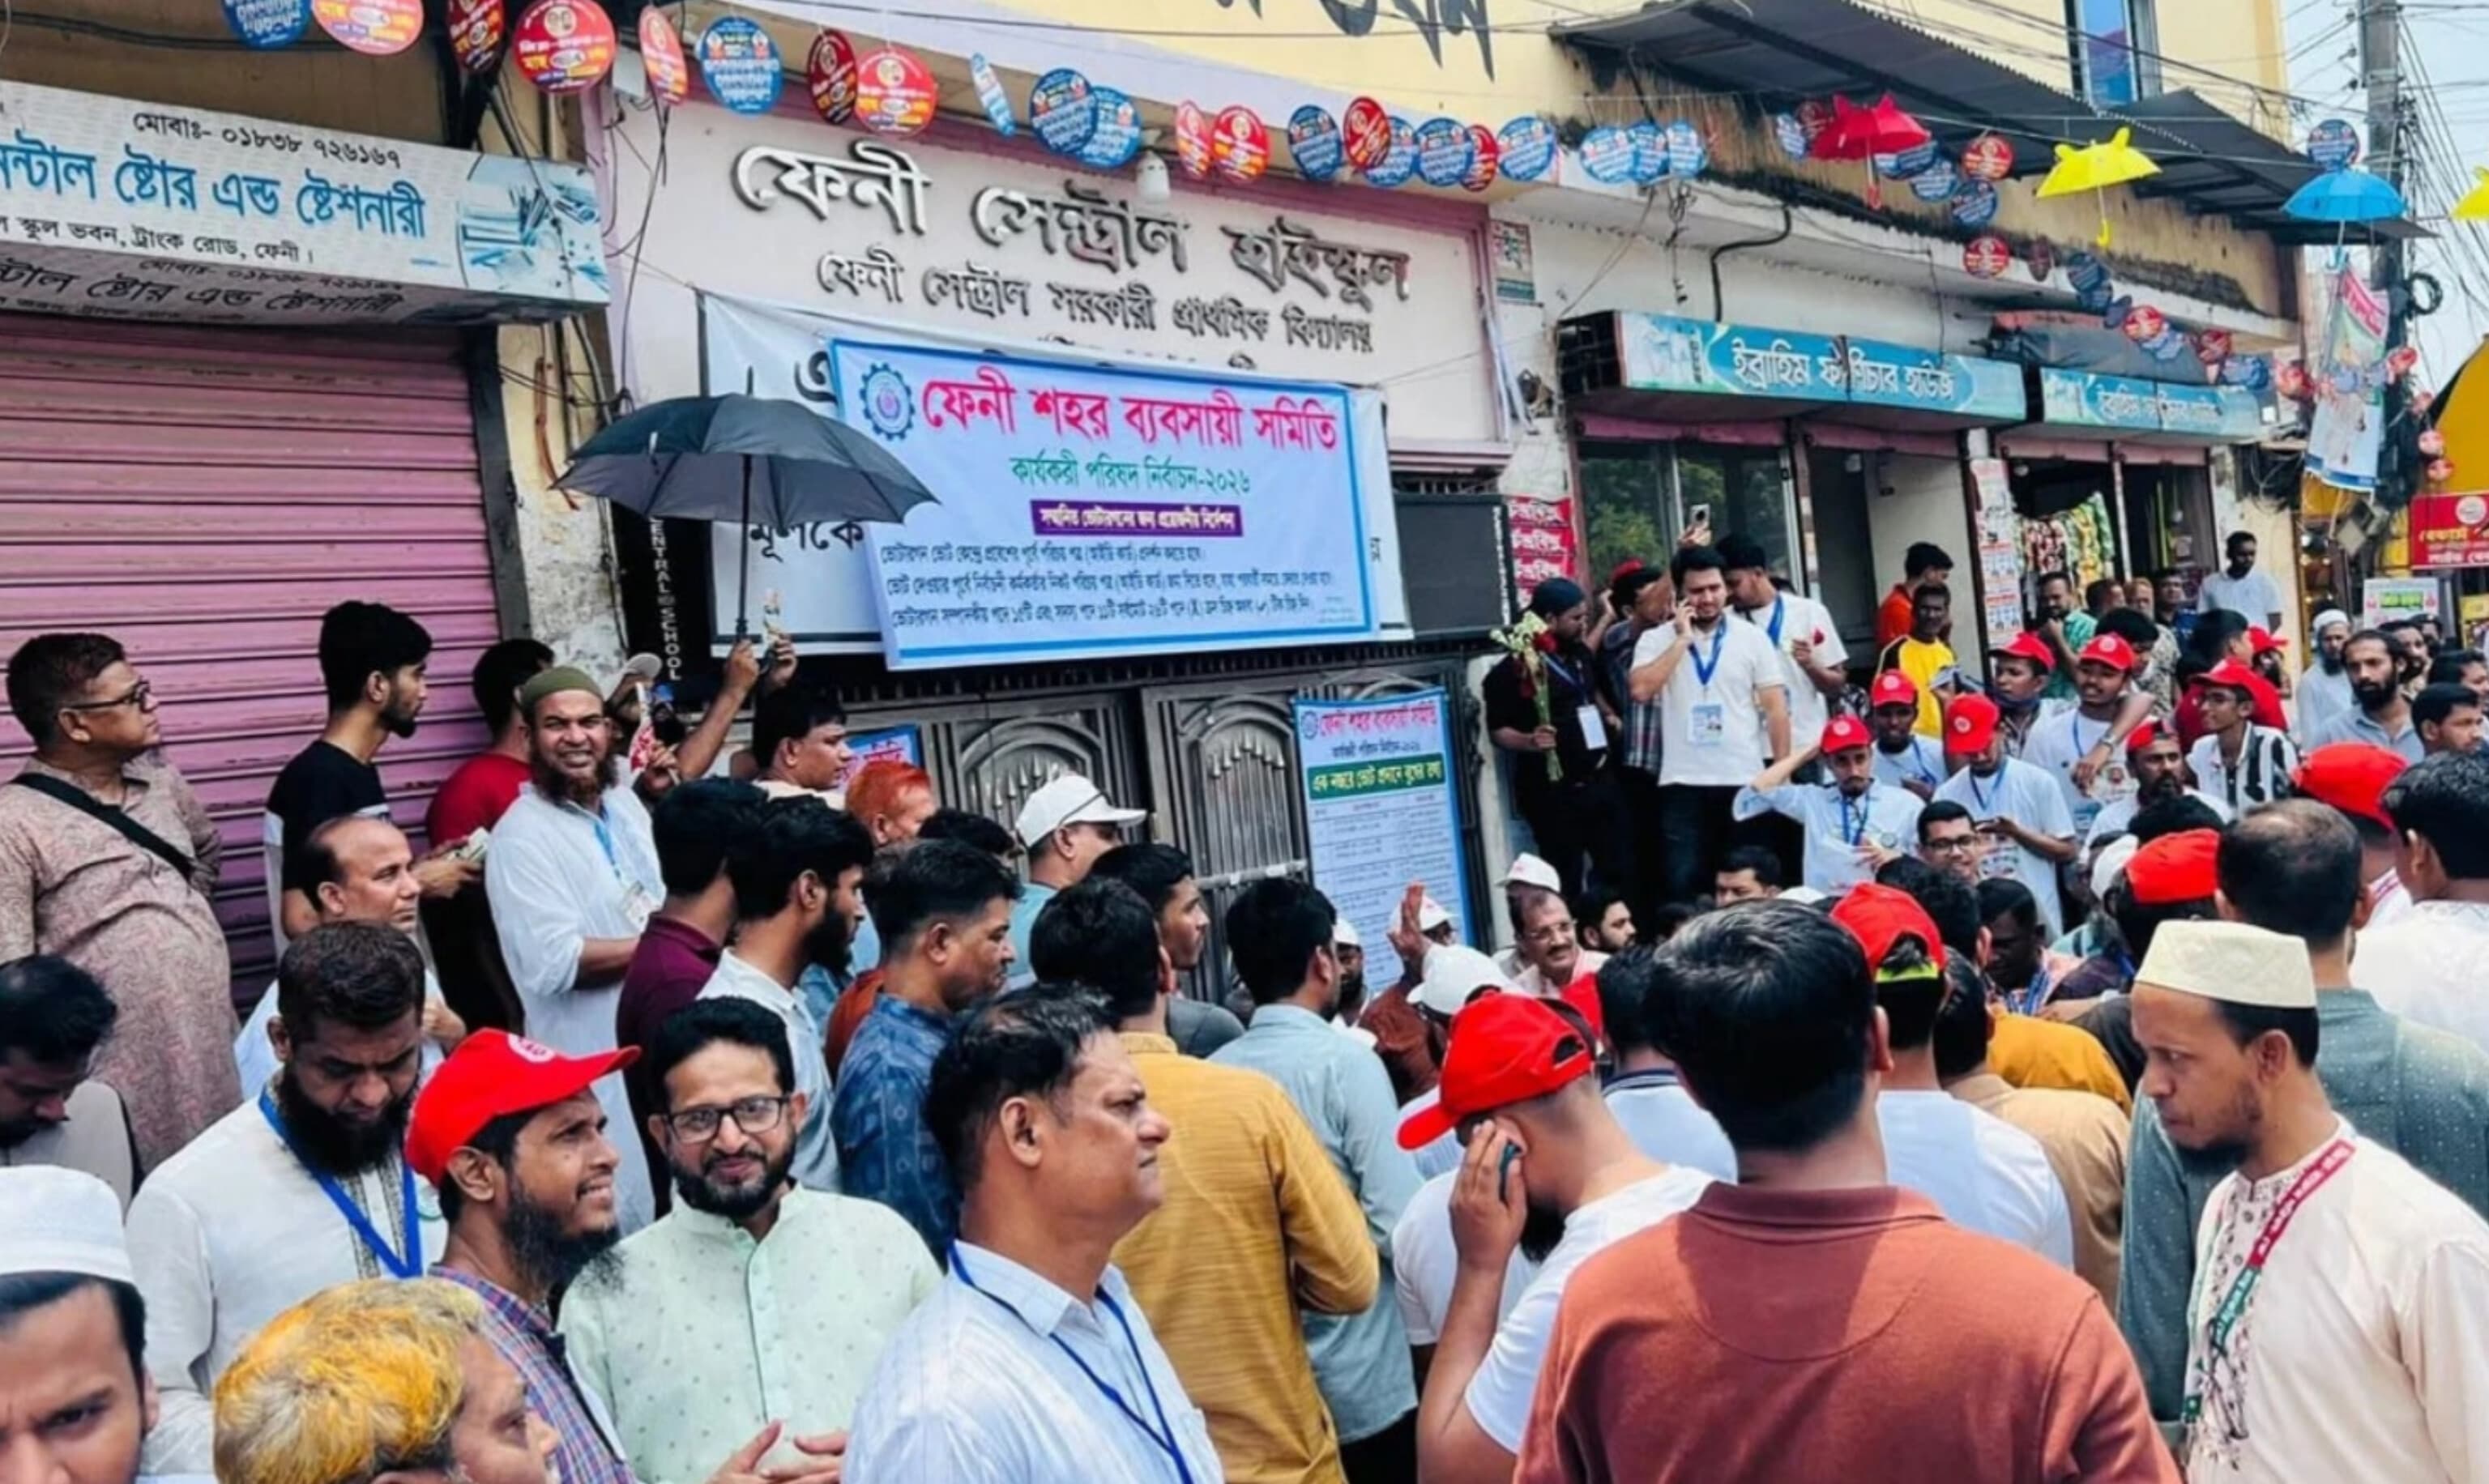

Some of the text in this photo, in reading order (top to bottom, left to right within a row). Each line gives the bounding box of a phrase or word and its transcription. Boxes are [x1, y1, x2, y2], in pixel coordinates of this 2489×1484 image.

[0, 128, 426, 239] ন্টাল ষ্টোর এন্ড ষ্টেশনারী
[221, 126, 304, 153] ০১৮৩৮
[314, 139, 401, 168] ৭২৬১৬৭
[16, 217, 59, 240] স্কুল
[254, 241, 301, 263] ফেনী
[732, 139, 1411, 313] ফেনী সেন্ট্রাল হাইস্কুল
[817, 244, 903, 304] ফেনী
[922, 260, 1031, 318] সেন্ট্রাল
[1046, 280, 1156, 331] সরকারী
[1172, 295, 1270, 341] প্রাথমিক
[1281, 301, 1373, 352] বিদ্যালয়
[1731, 337, 1811, 389] ইব্রাহিম
[923, 363, 1338, 451] ফেনী শহর ব্যবসায়ী সমিতি
[1010, 448, 1251, 496] কার্যকরী পরিষদ নির্বাচন-২০২৬
[650, 516, 671, 594] ENTRAL
